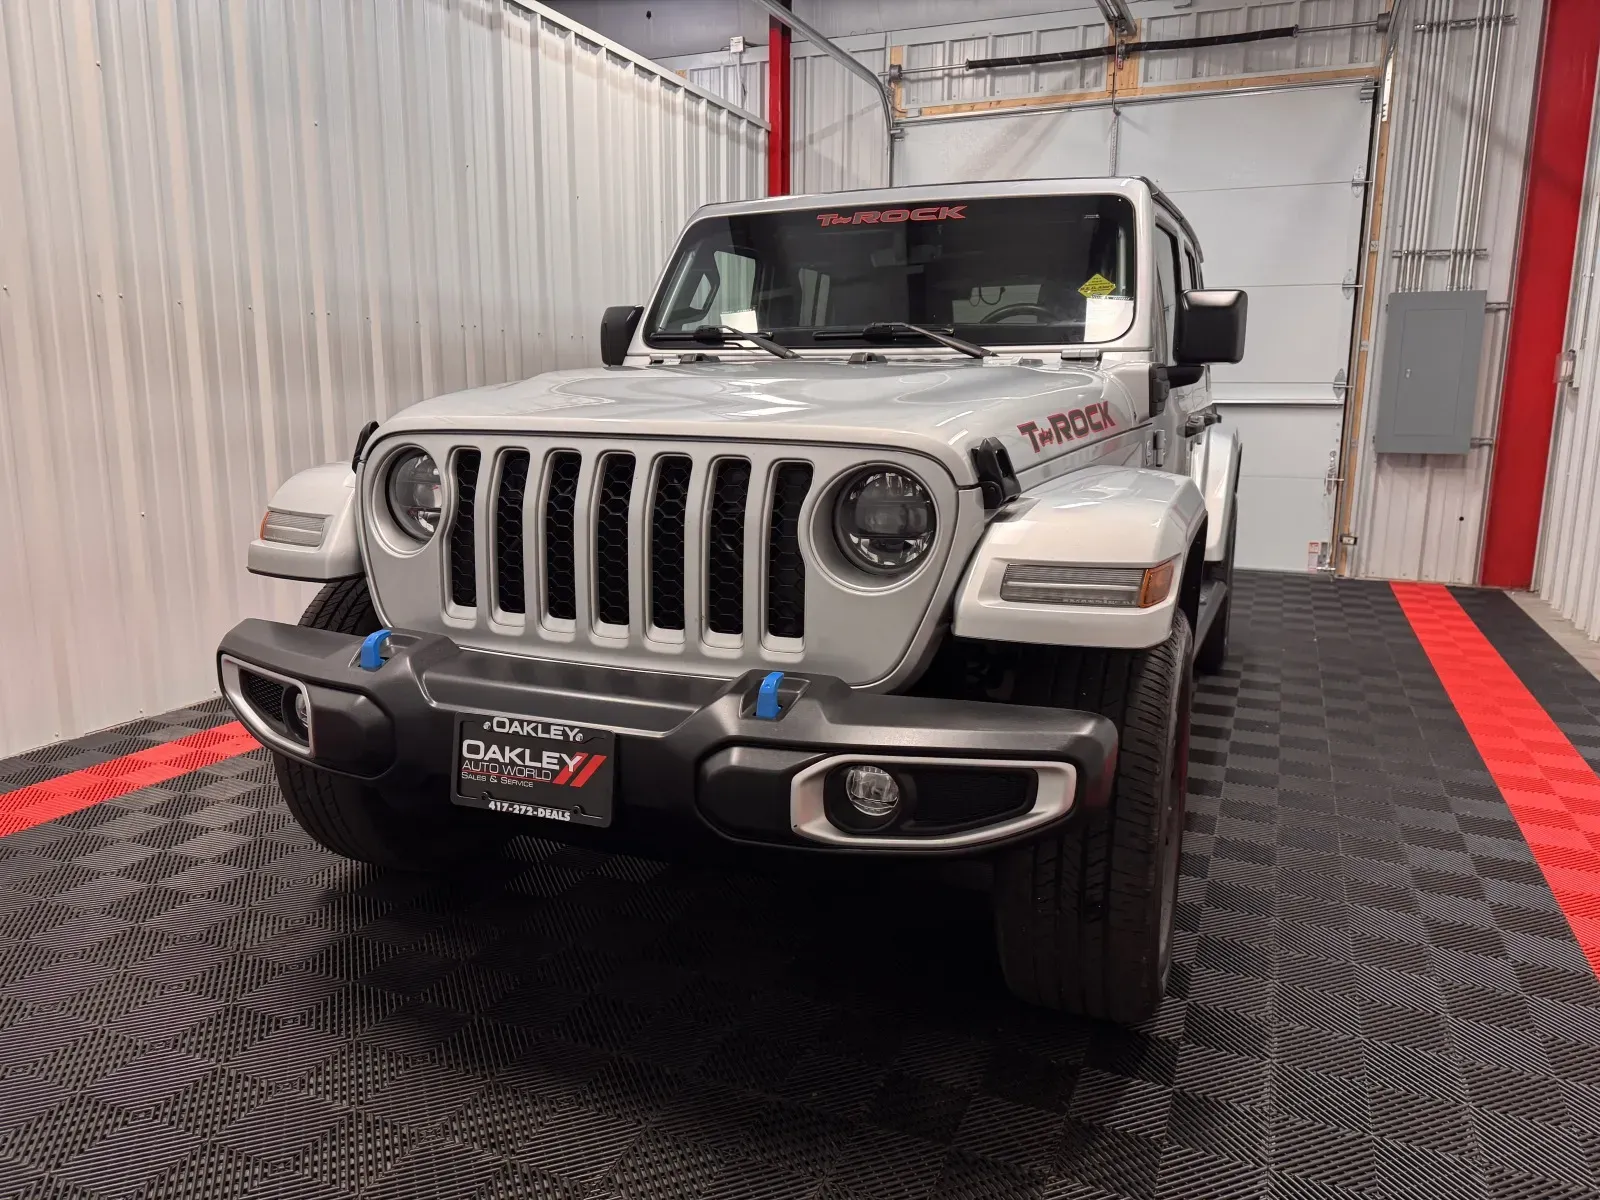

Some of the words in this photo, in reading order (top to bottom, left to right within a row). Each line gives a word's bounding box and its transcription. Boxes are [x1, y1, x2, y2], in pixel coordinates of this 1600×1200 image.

[493, 716, 580, 742] OAKLEY
[462, 739, 583, 773] OAKLEY
[461, 772, 487, 782] SALES
[500, 776, 534, 788] SERVICE
[462, 759, 499, 774] AUTO
[502, 764, 552, 781] WORLD
[488, 801, 571, 822] 417-272-DEALS
